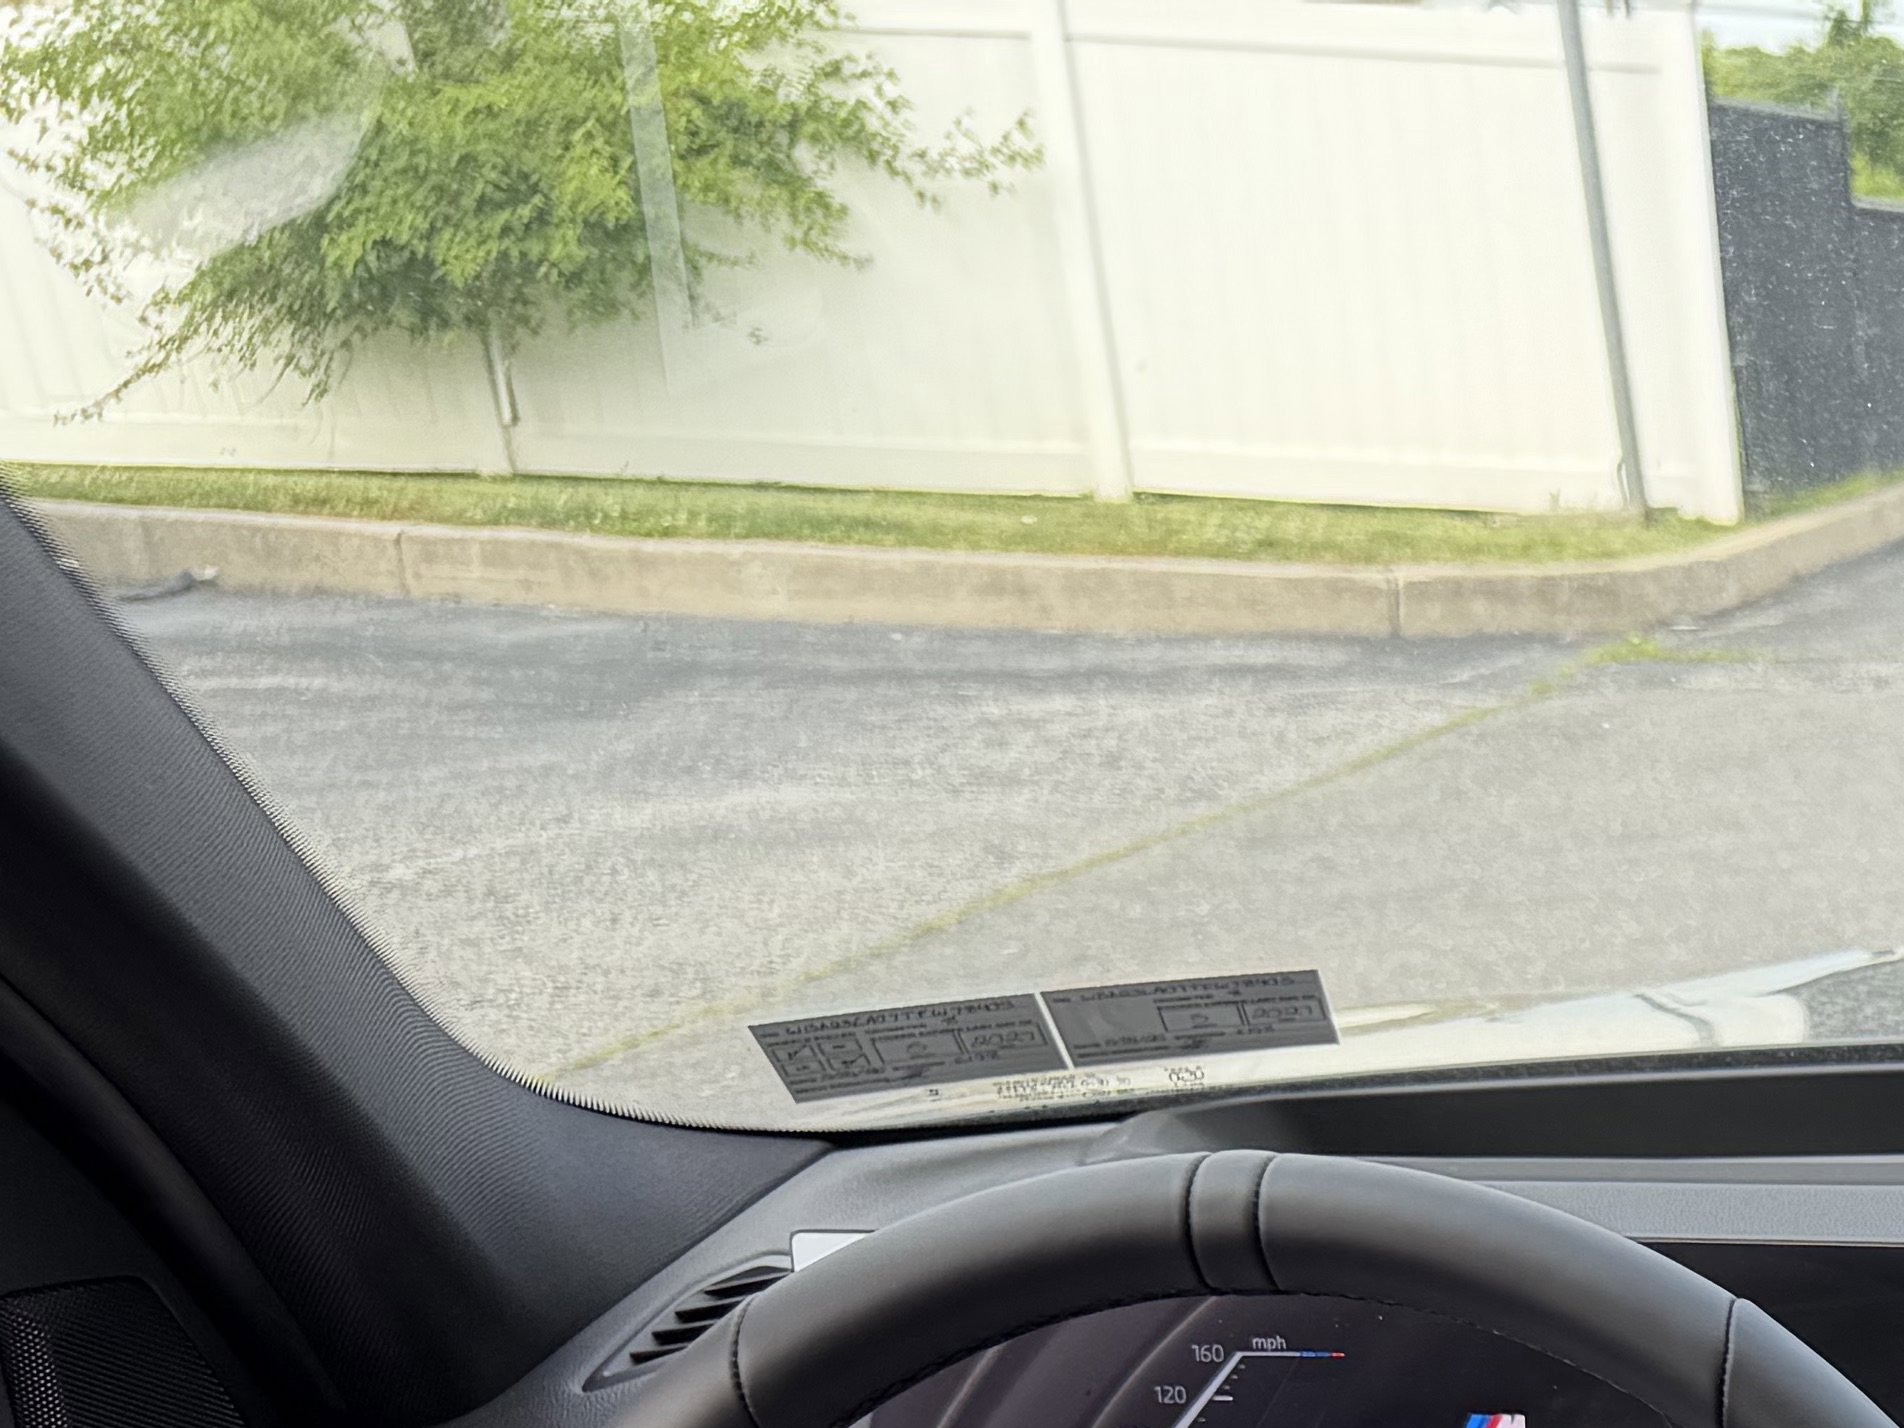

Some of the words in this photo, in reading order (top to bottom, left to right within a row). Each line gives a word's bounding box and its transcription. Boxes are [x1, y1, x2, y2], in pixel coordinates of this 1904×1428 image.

[1251, 1336, 1287, 1351] mph
[1191, 1344, 1225, 1363] 160
[1154, 1385, 1187, 1404] 120
